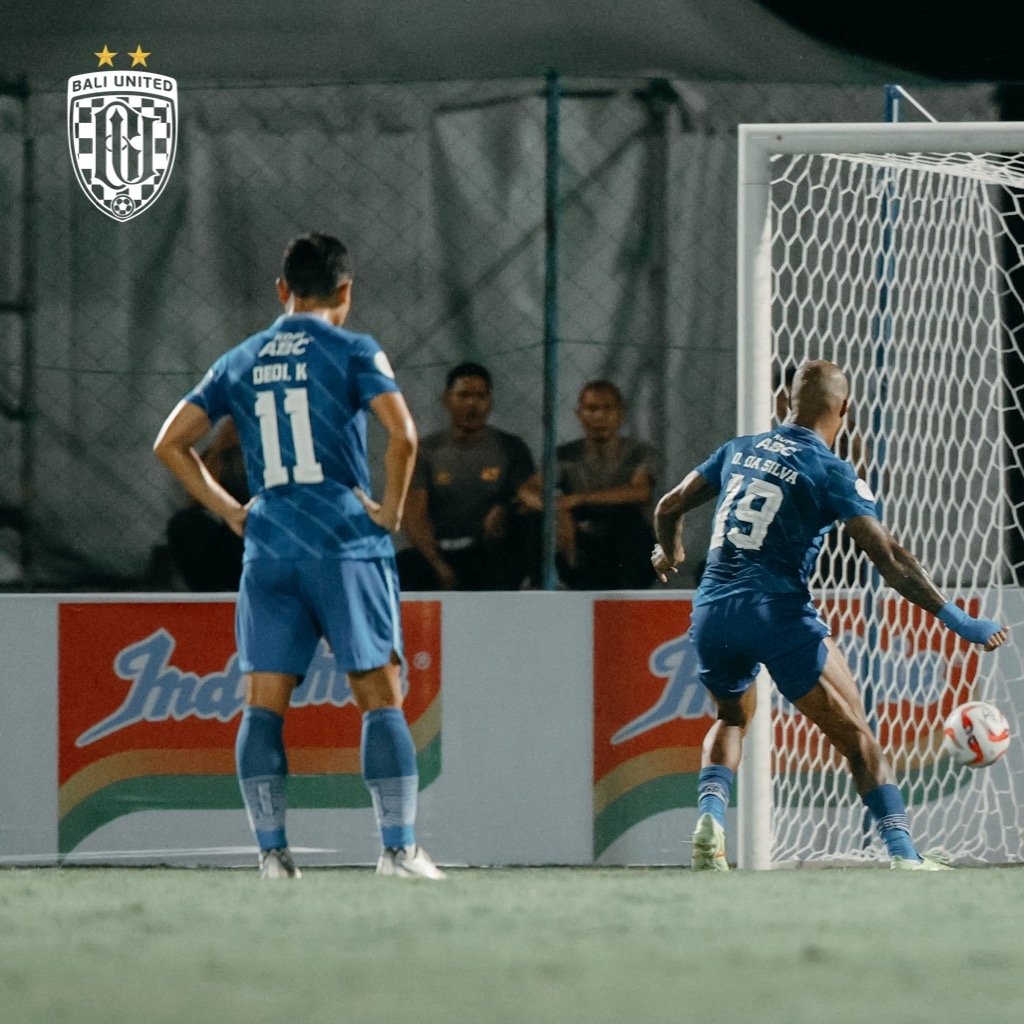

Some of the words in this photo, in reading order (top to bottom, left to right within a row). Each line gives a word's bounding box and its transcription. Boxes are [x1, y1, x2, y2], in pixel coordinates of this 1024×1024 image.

[295, 362, 308, 382] K
[254, 387, 325, 489] 11
[743, 455, 759, 471] DA
[763, 461, 799, 485] SILVA
[710, 472, 784, 551] 19
